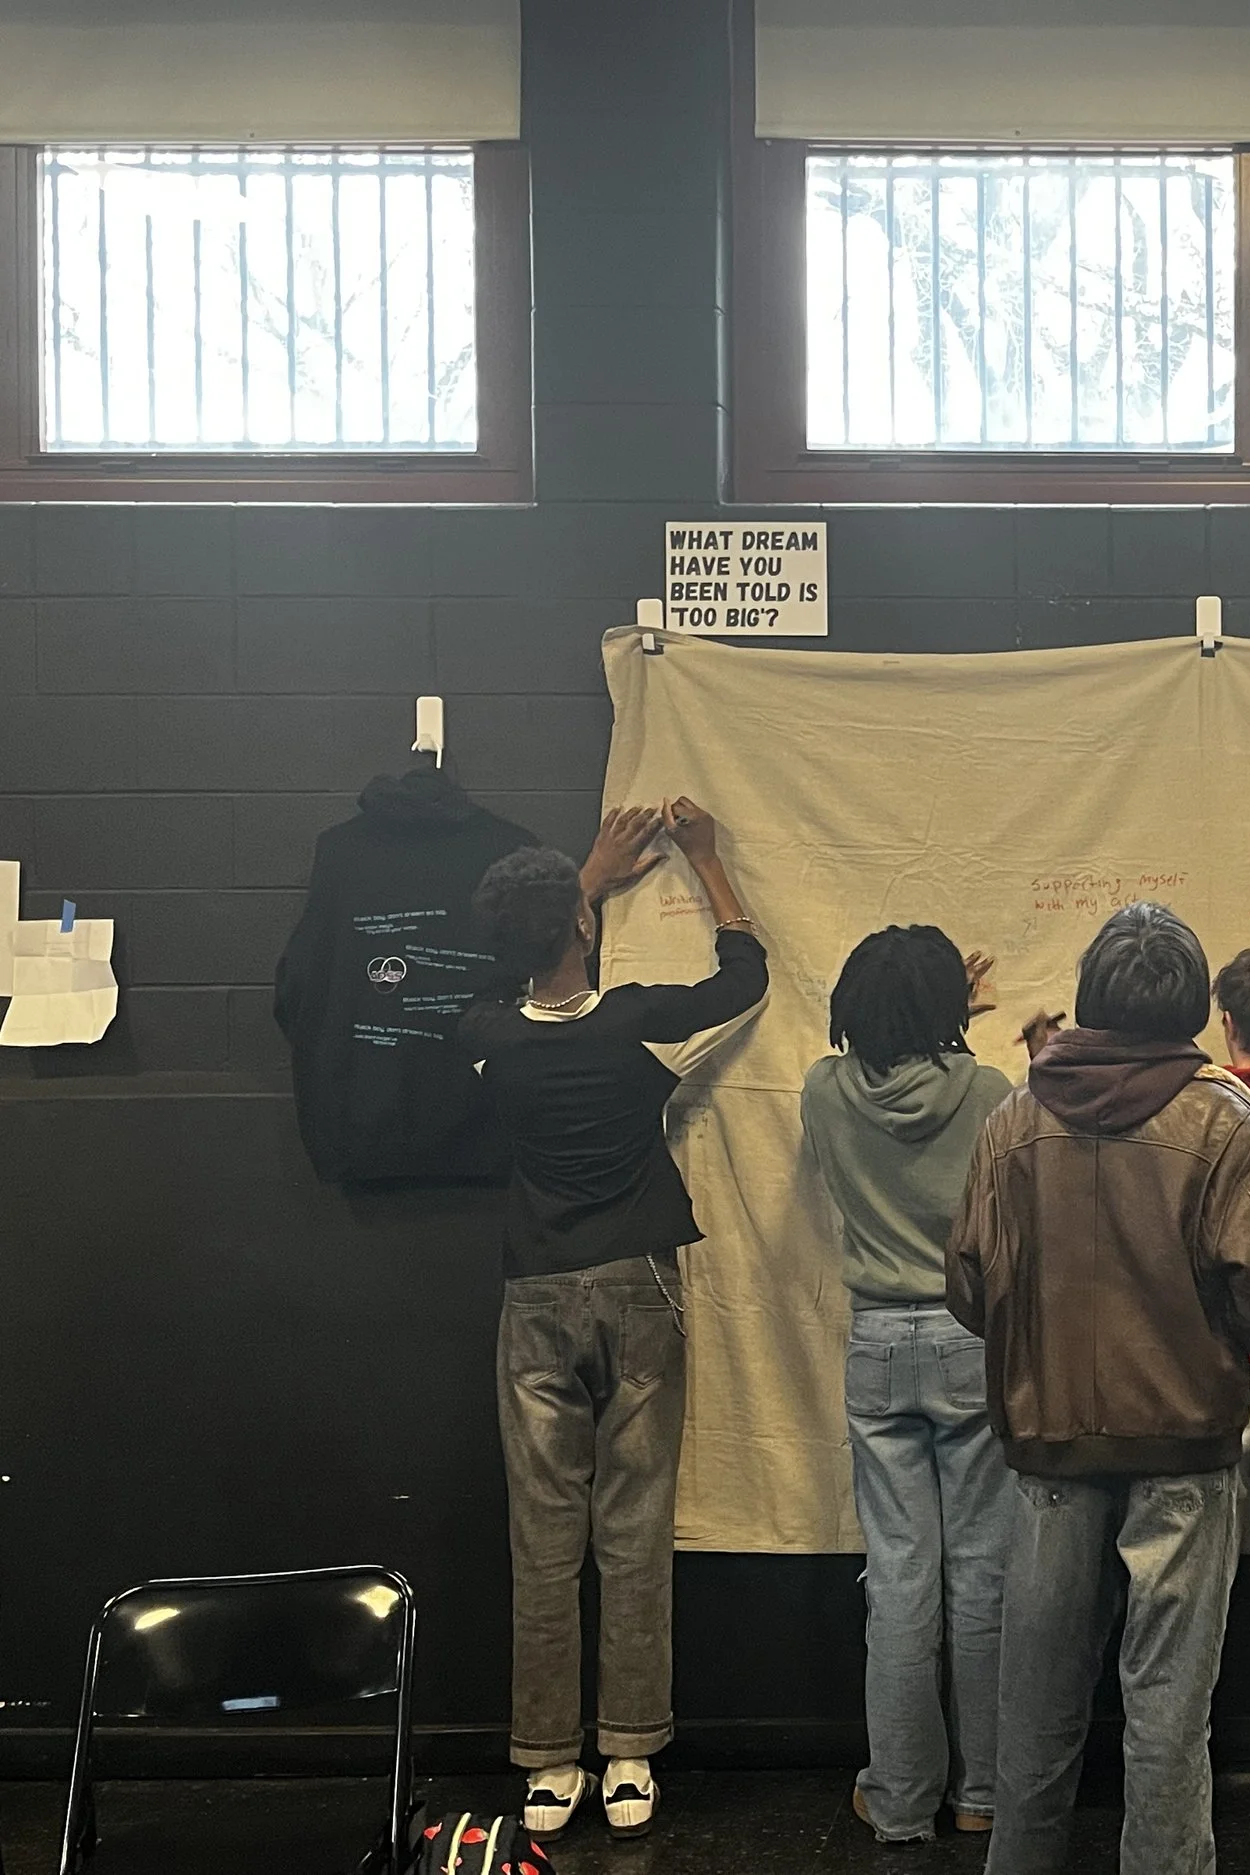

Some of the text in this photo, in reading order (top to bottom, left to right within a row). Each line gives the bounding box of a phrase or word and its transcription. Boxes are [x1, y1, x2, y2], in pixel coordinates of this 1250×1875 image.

[670, 531, 817, 550] WHAT DREAM
[671, 556, 781, 576] HAVE YOU
[671, 582, 817, 602] BEEN TOLD IS
[1031, 871, 1189, 896] Supporting myself
[1076, 895, 1098, 916] my
